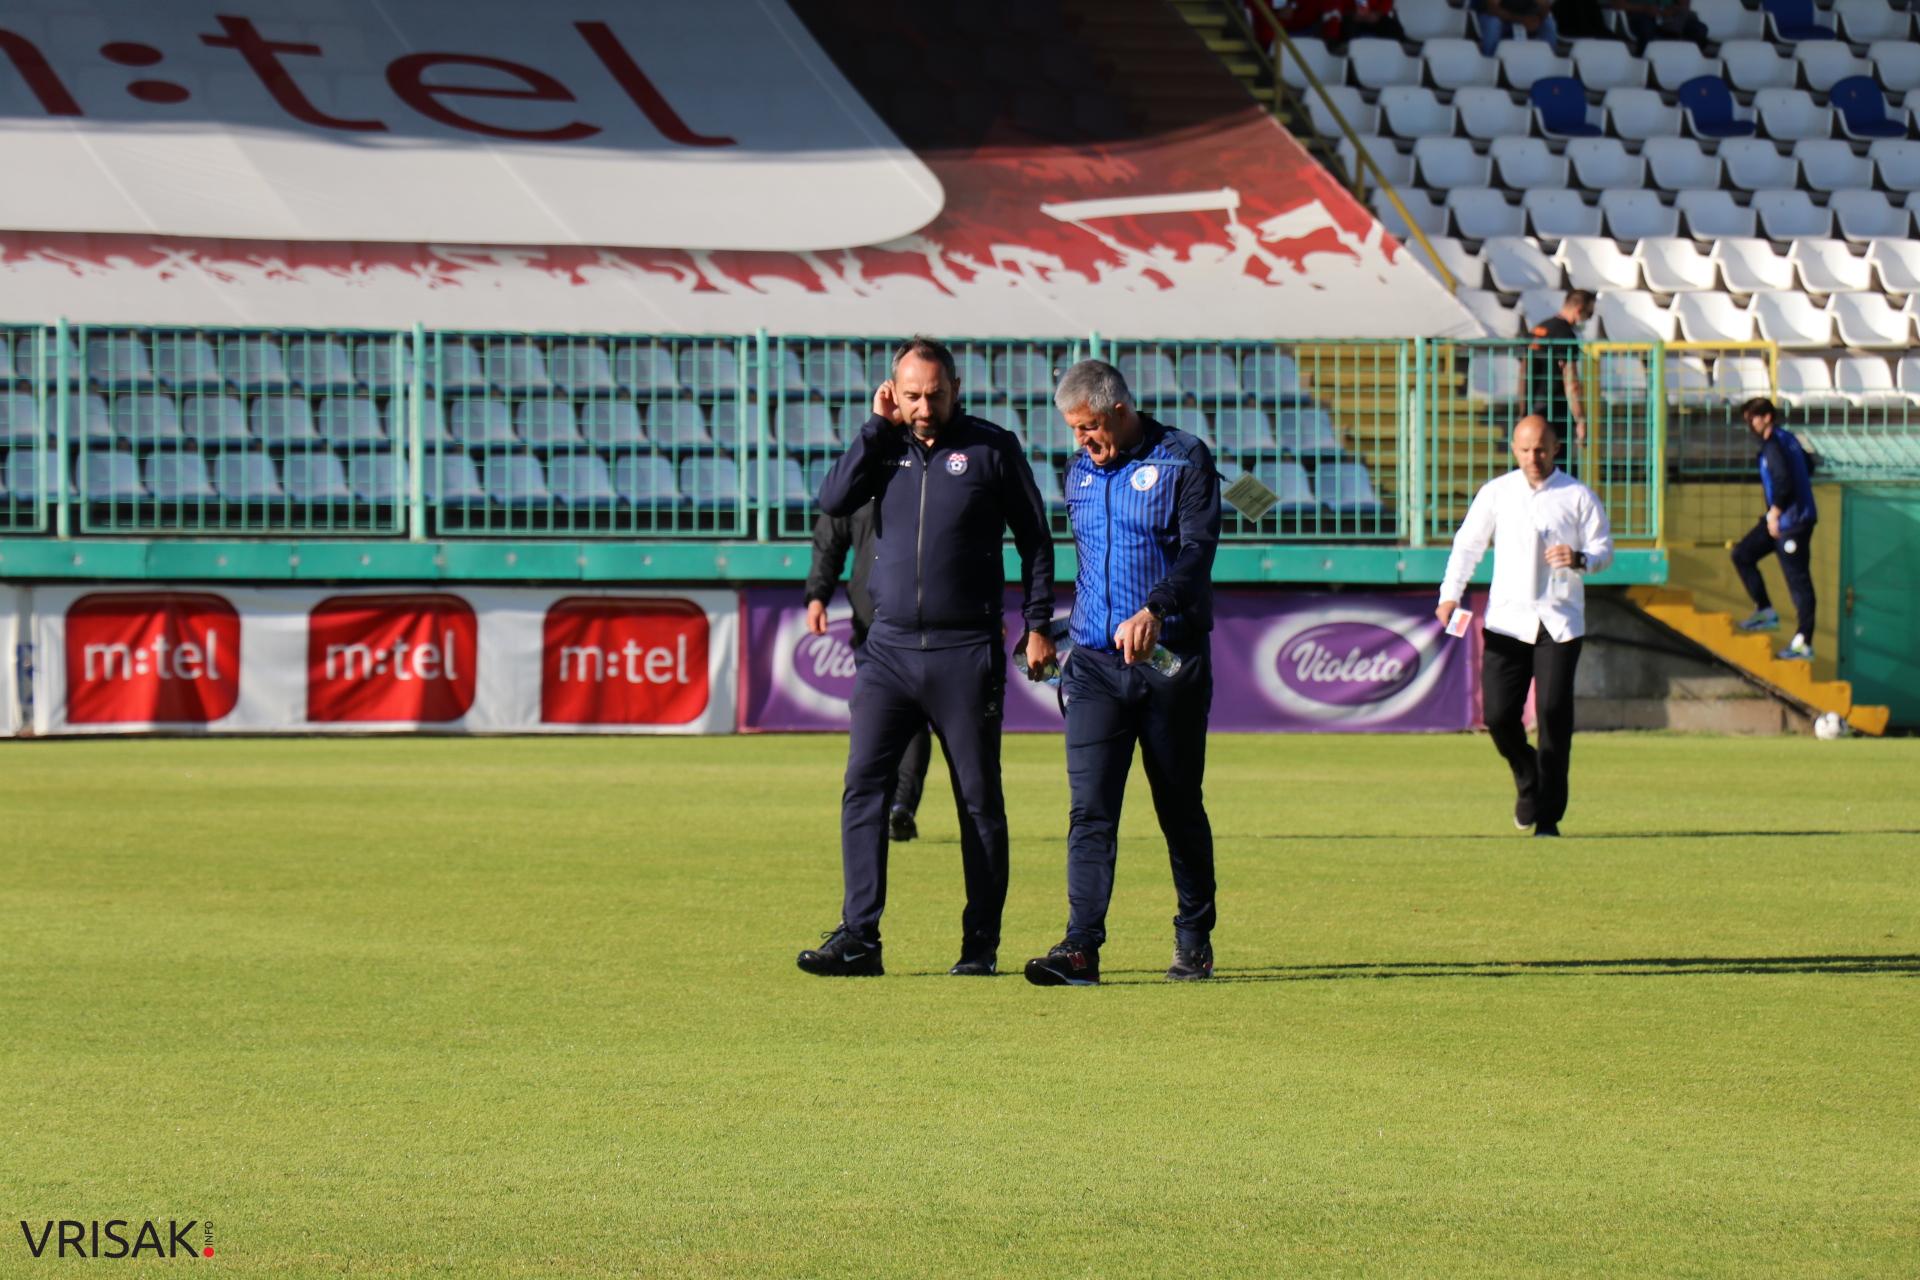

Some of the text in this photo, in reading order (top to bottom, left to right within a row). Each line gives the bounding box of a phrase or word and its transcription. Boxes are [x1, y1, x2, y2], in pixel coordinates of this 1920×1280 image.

[881, 458, 912, 467] ELME
[84, 629, 220, 681] m:tel
[326, 629, 459, 681] m:tel
[560, 632, 691, 684] m:tel
[808, 634, 857, 678] Vio
[1291, 639, 1404, 682] Violeta
